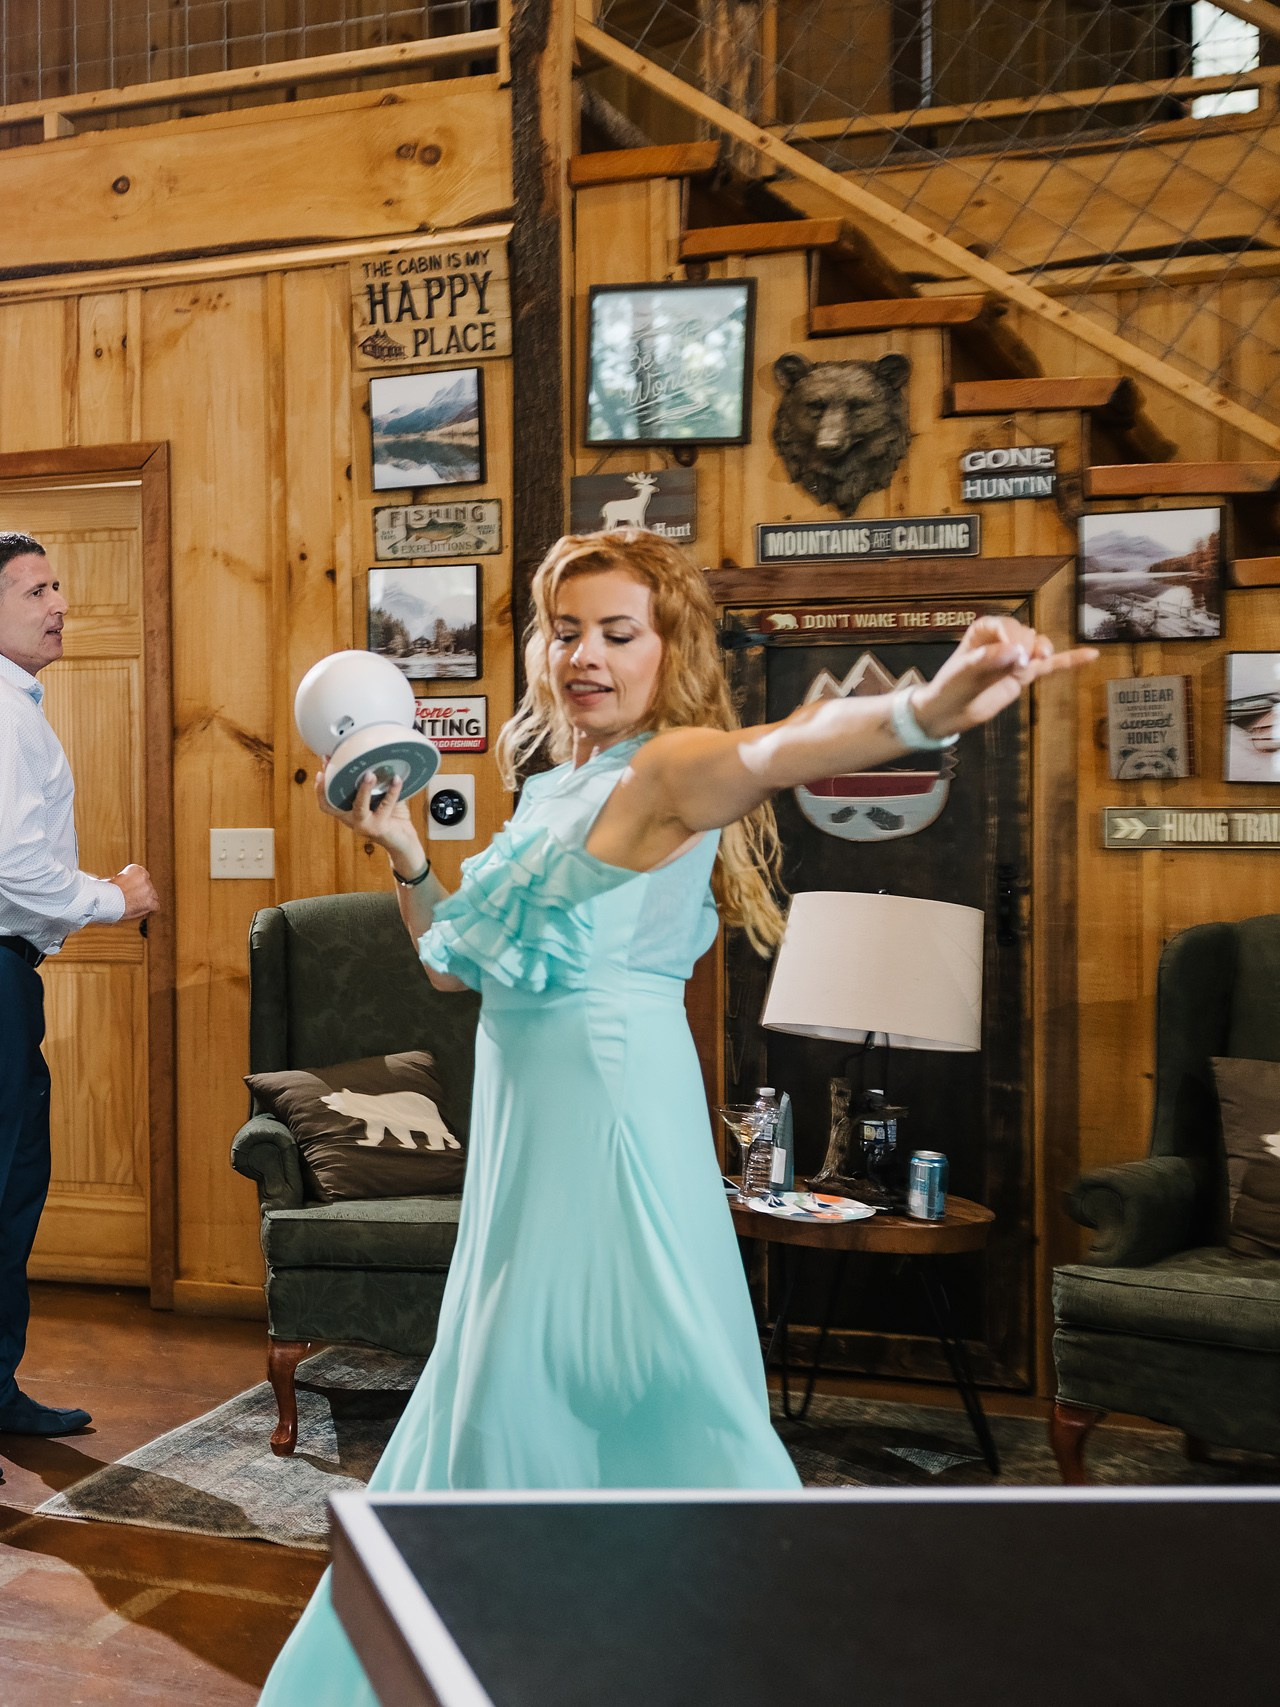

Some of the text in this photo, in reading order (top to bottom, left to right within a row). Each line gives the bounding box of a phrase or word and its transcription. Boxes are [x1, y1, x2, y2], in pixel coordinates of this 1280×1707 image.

[362, 249, 491, 280] THE CABIN IS MY
[366, 270, 493, 325] HAPPY
[412, 322, 496, 358] PLACE
[961, 447, 1056, 472] GONE
[963, 475, 1057, 499] HUNTIN'
[390, 505, 484, 528] FISHING
[654, 522, 691, 537] Hunt
[765, 523, 970, 557] MOUNTAINS ARE CALLING
[401, 541, 472, 554] EXPEDITIONS
[803, 611, 977, 630] DON'T WAKE THE BEAR
[1117, 688, 1174, 704] OLD BEAR
[413, 718, 481, 736] NTING
[1127, 730, 1167, 745] HONEY
[450, 740, 482, 748] FISHING!
[1163, 812, 1280, 842] HIKING TRAI
